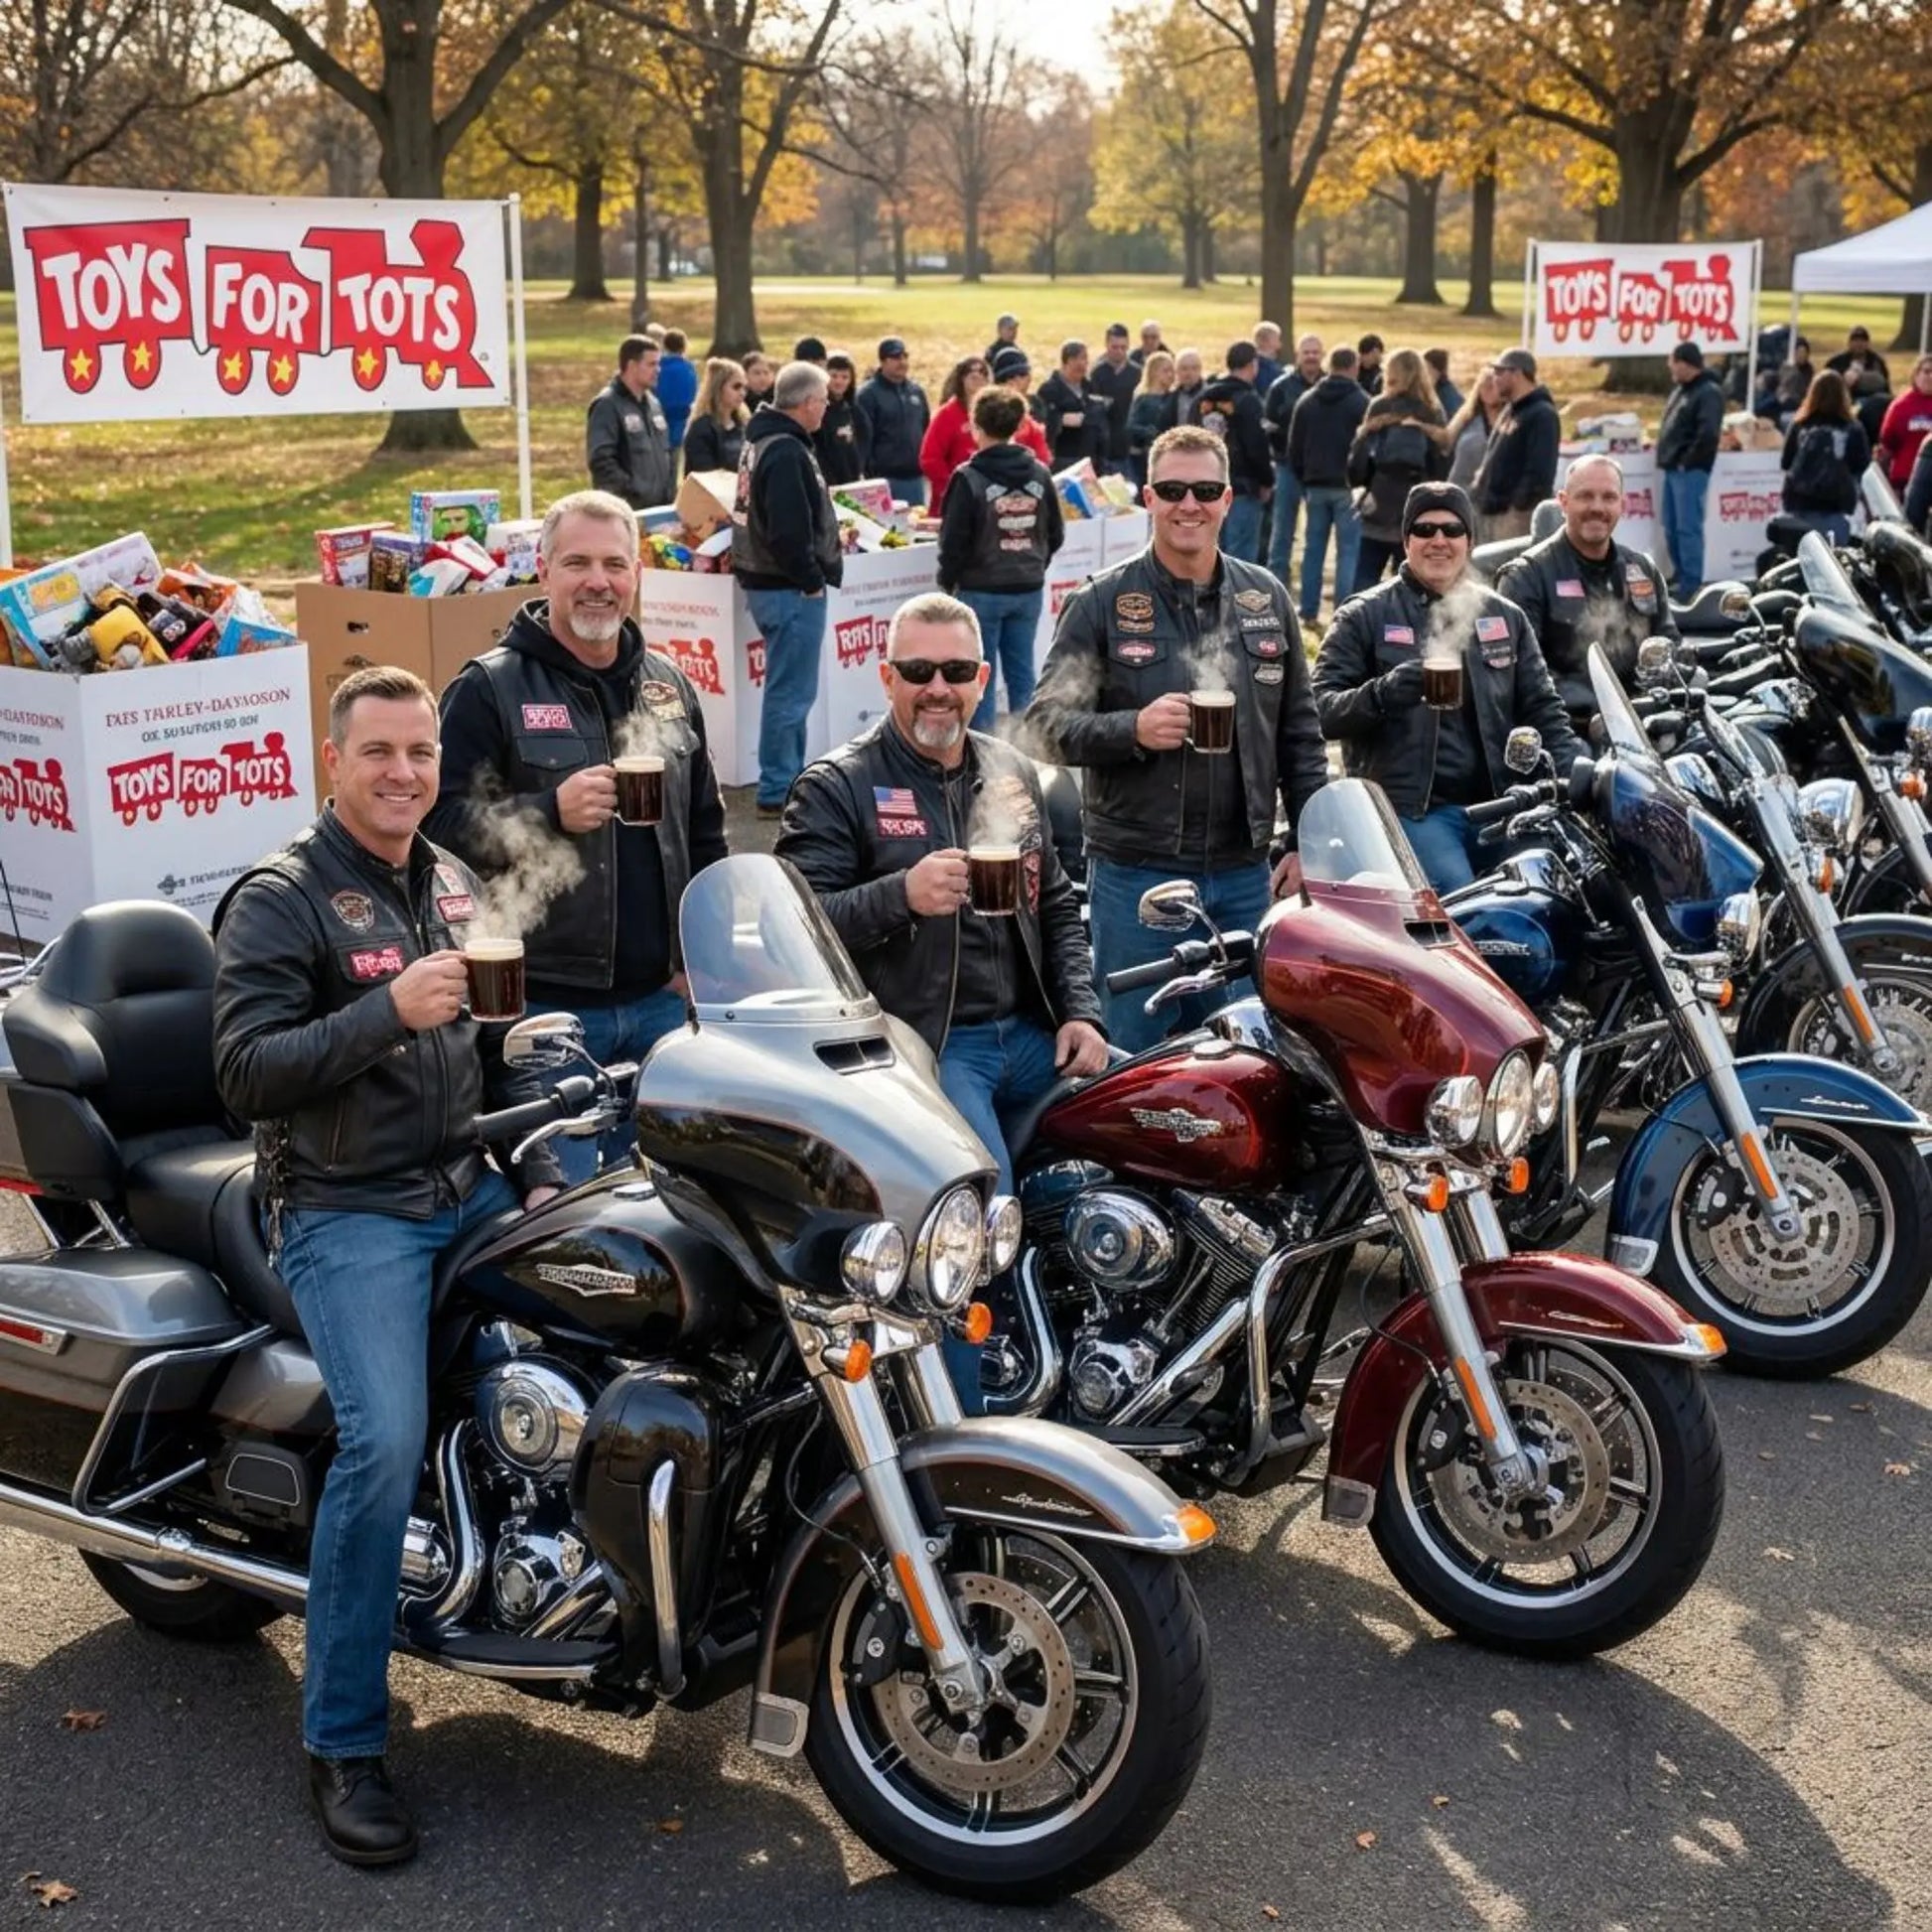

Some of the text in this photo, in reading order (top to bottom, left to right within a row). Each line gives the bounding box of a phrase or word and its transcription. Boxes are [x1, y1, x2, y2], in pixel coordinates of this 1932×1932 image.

[43, 243, 462, 350] TOYS FOR TOTS
[1549, 270, 1728, 323] TOYS FOR TOTS
[114, 763, 171, 803] TOYS
[183, 765, 222, 793] FOR
